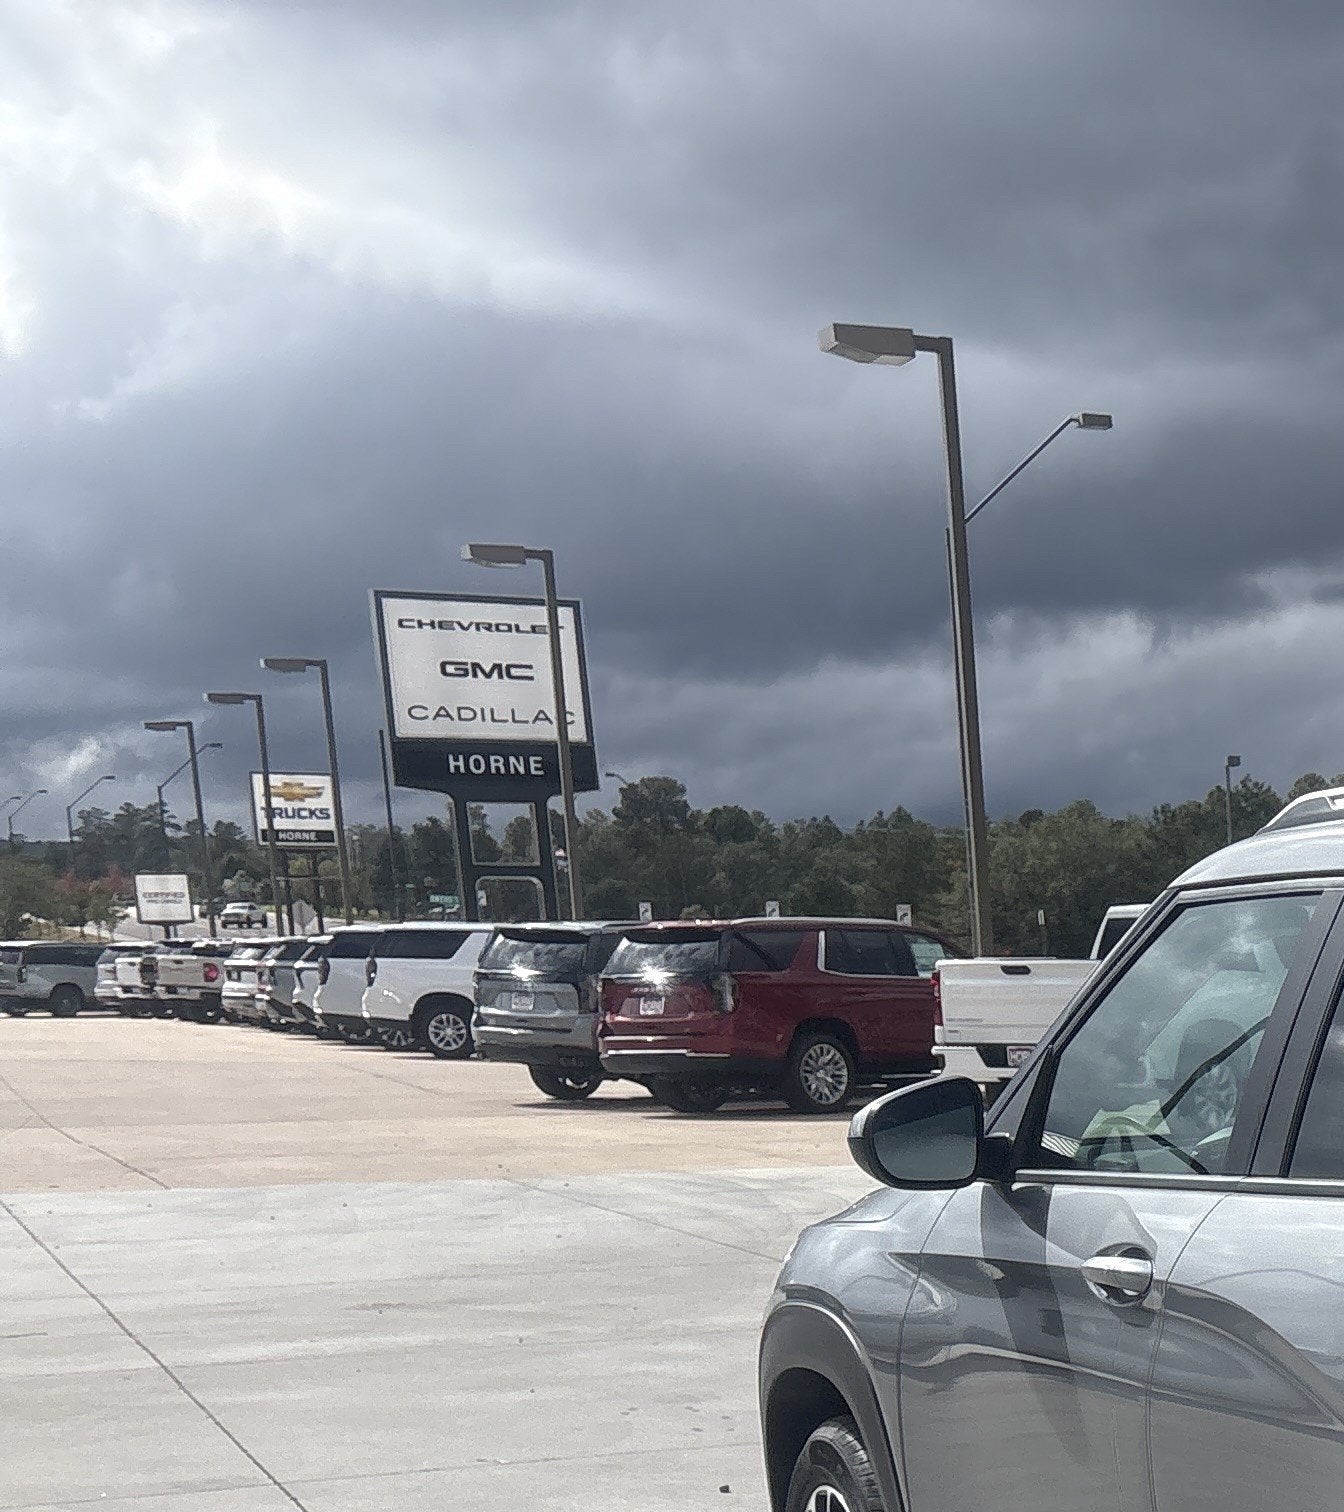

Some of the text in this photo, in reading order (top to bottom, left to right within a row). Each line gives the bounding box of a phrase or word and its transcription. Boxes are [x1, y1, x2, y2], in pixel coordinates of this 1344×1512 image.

[439, 660, 535, 681] GMC
[448, 754, 546, 776] HORNE
[278, 831, 318, 841] HORNE
